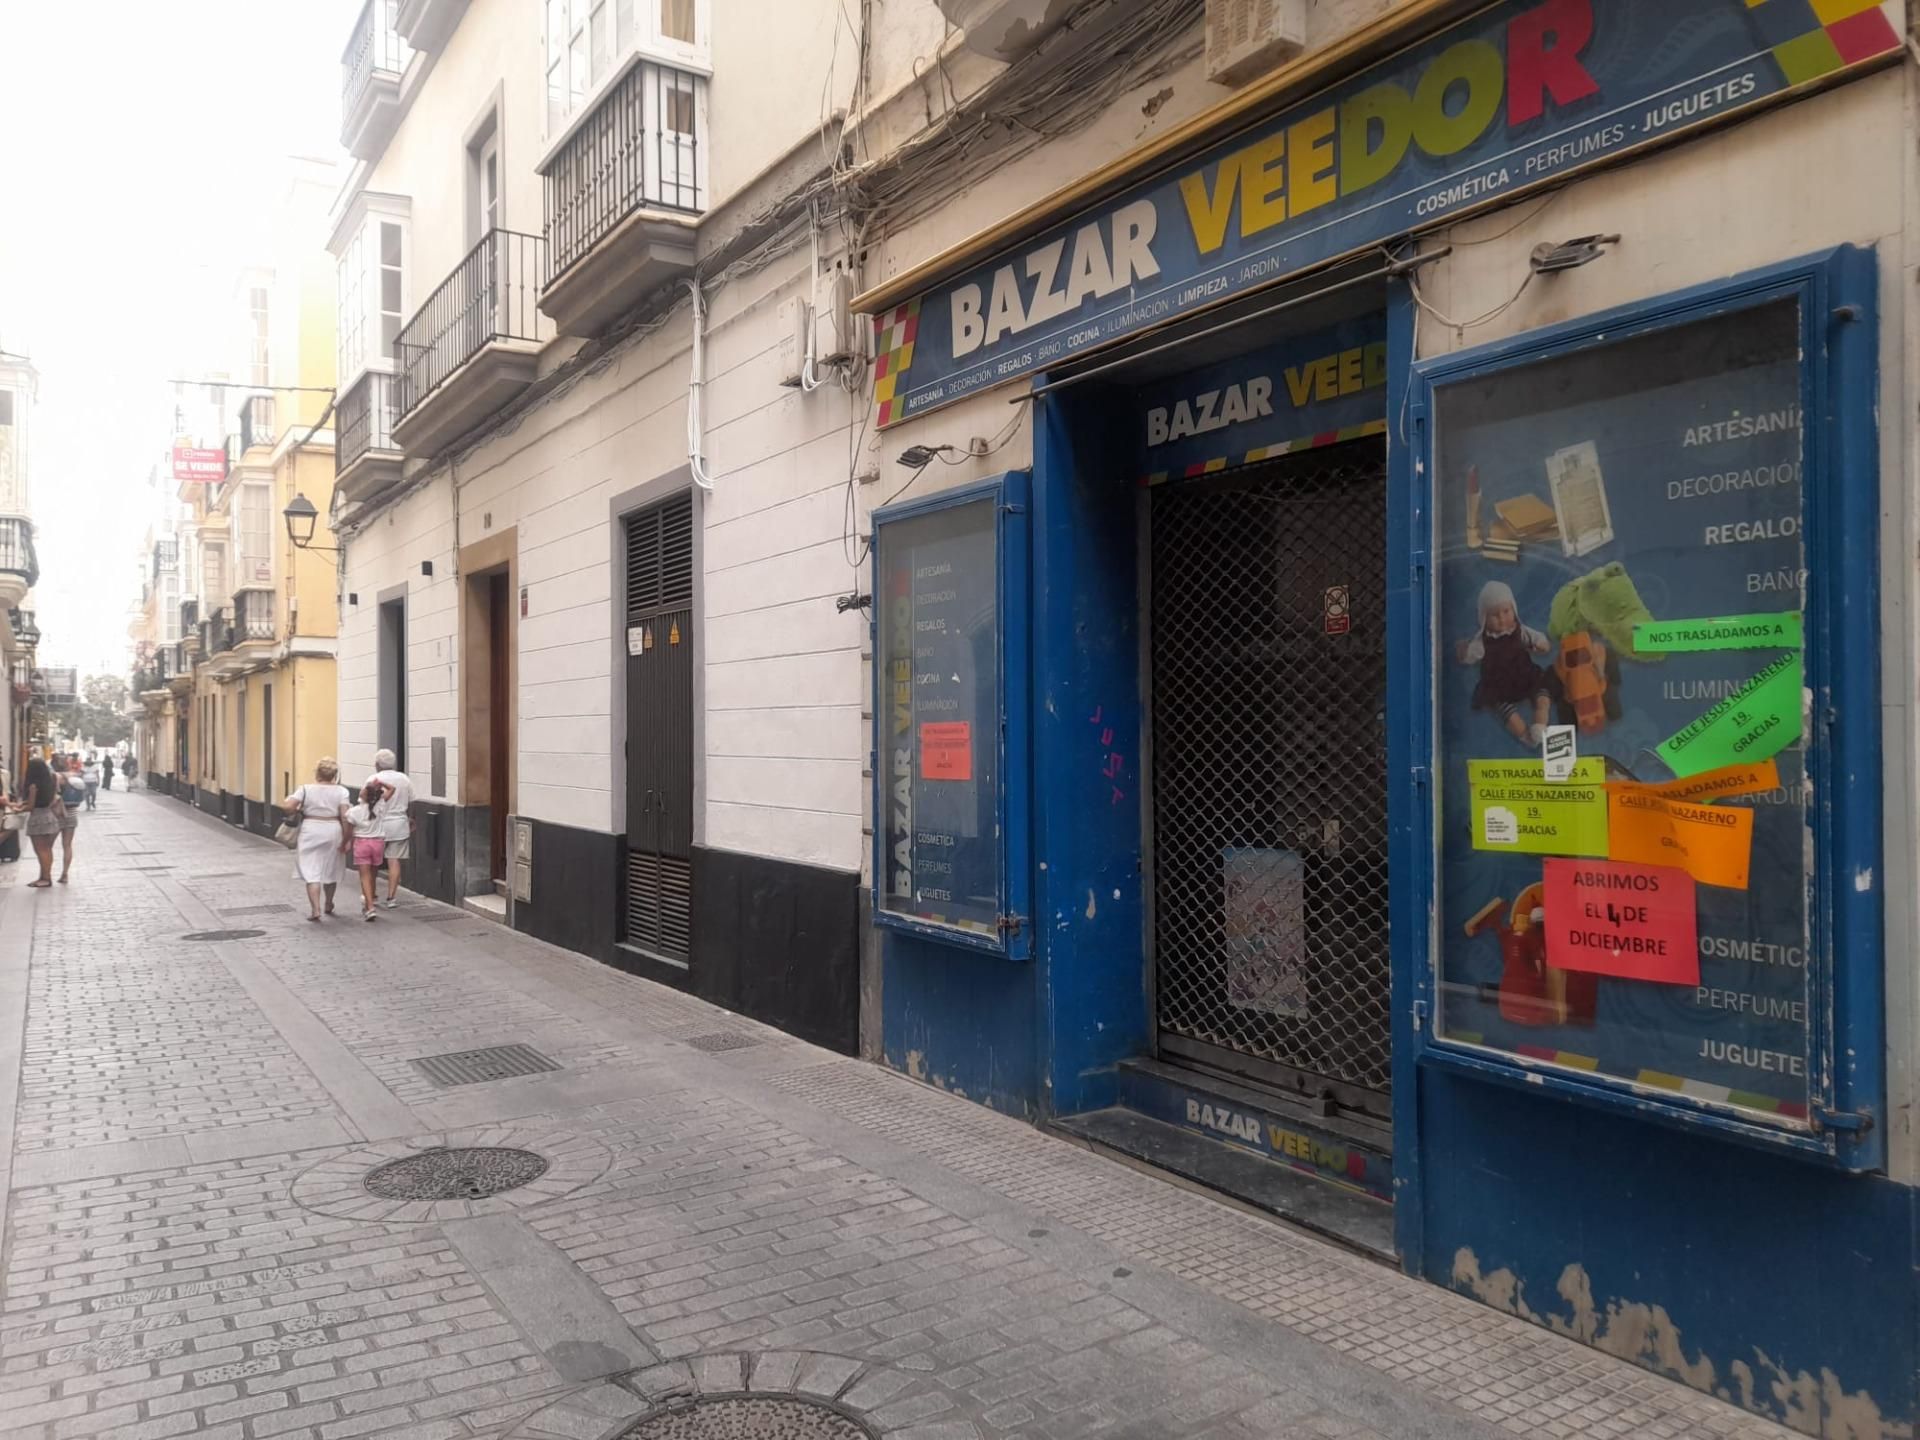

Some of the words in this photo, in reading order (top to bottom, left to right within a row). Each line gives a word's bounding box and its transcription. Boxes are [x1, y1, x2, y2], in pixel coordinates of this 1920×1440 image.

[949, 198, 1161, 359] BAZAR
[1178, 0, 1600, 256] VEEDOR
[908, 386, 944, 409] ARTESANÍA
[948, 368, 992, 394] DECORACIÓN
[997, 353, 1032, 375] REGALOS
[1067, 325, 1100, 348] COCINA
[1107, 298, 1169, 333] ILUMINACIÓN
[1177, 276, 1228, 306] LIMPIEZA
[1238, 256, 1280, 284] JARDÍN
[1416, 168, 1509, 216] COSMÉTICA
[1525, 123, 1625, 176] PERFUMES
[1642, 73, 1756, 132] JUGUETES
[1147, 376, 1274, 447] BAZAR
[1650, 632, 1673, 644] NOS
[1676, 624, 1770, 641] TRASLADAMOS
[1774, 624, 1784, 635] A
[1669, 721, 1701, 751] CALLE
[1731, 651, 1794, 702] NAZARENO
[1733, 714, 1781, 753] GRACIAS
[1481, 769, 1500, 779] NOS
[1503, 768, 1578, 779] TRASLADS
[1581, 768, 1589, 777] A
[1749, 773, 1759, 784] A
[1480, 788, 1505, 799] CALLE
[1536, 790, 1595, 800] NAZARENO
[894, 749, 912, 898] BAZAR
[1573, 871, 1659, 891] ABRIMOS
[1585, 902, 1602, 919] EL
[1607, 902, 1621, 928] 4
[1623, 906, 1648, 923] DE
[1569, 930, 1668, 956] DICIEMBRE
[1699, 936, 1807, 968] OSMÉTIC
[1186, 1098, 1262, 1144] BAZAR
[1267, 1124, 1367, 1179] VEEDOR
